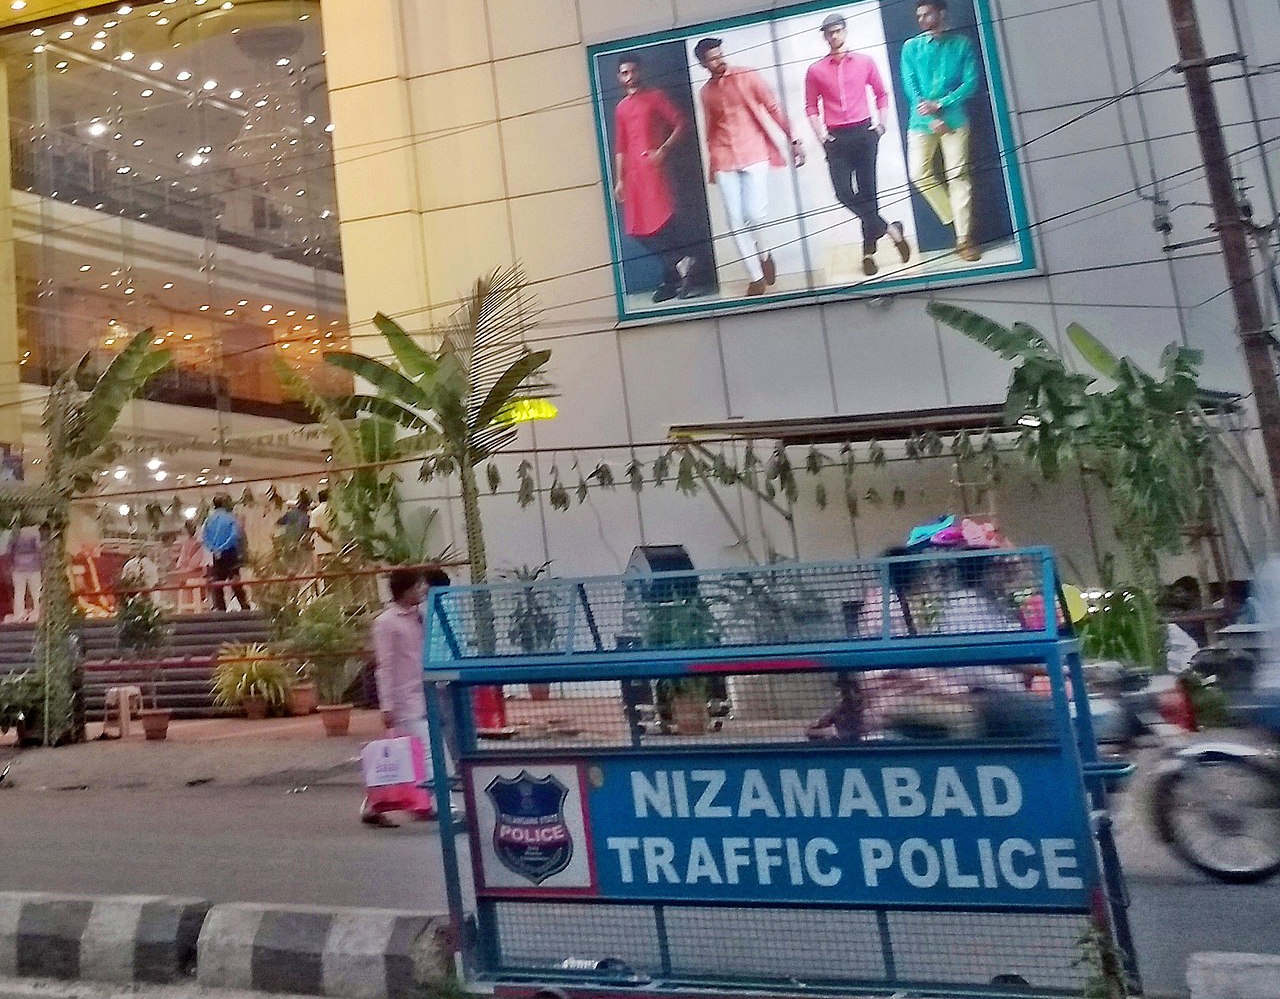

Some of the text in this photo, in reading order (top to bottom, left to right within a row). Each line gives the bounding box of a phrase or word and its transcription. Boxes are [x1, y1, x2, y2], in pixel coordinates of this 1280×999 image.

[629, 765, 1022, 818] NIZAMABAD
[499, 824, 565, 841] POLICE
[606, 836, 1085, 890] TRAFFIC POLICE
